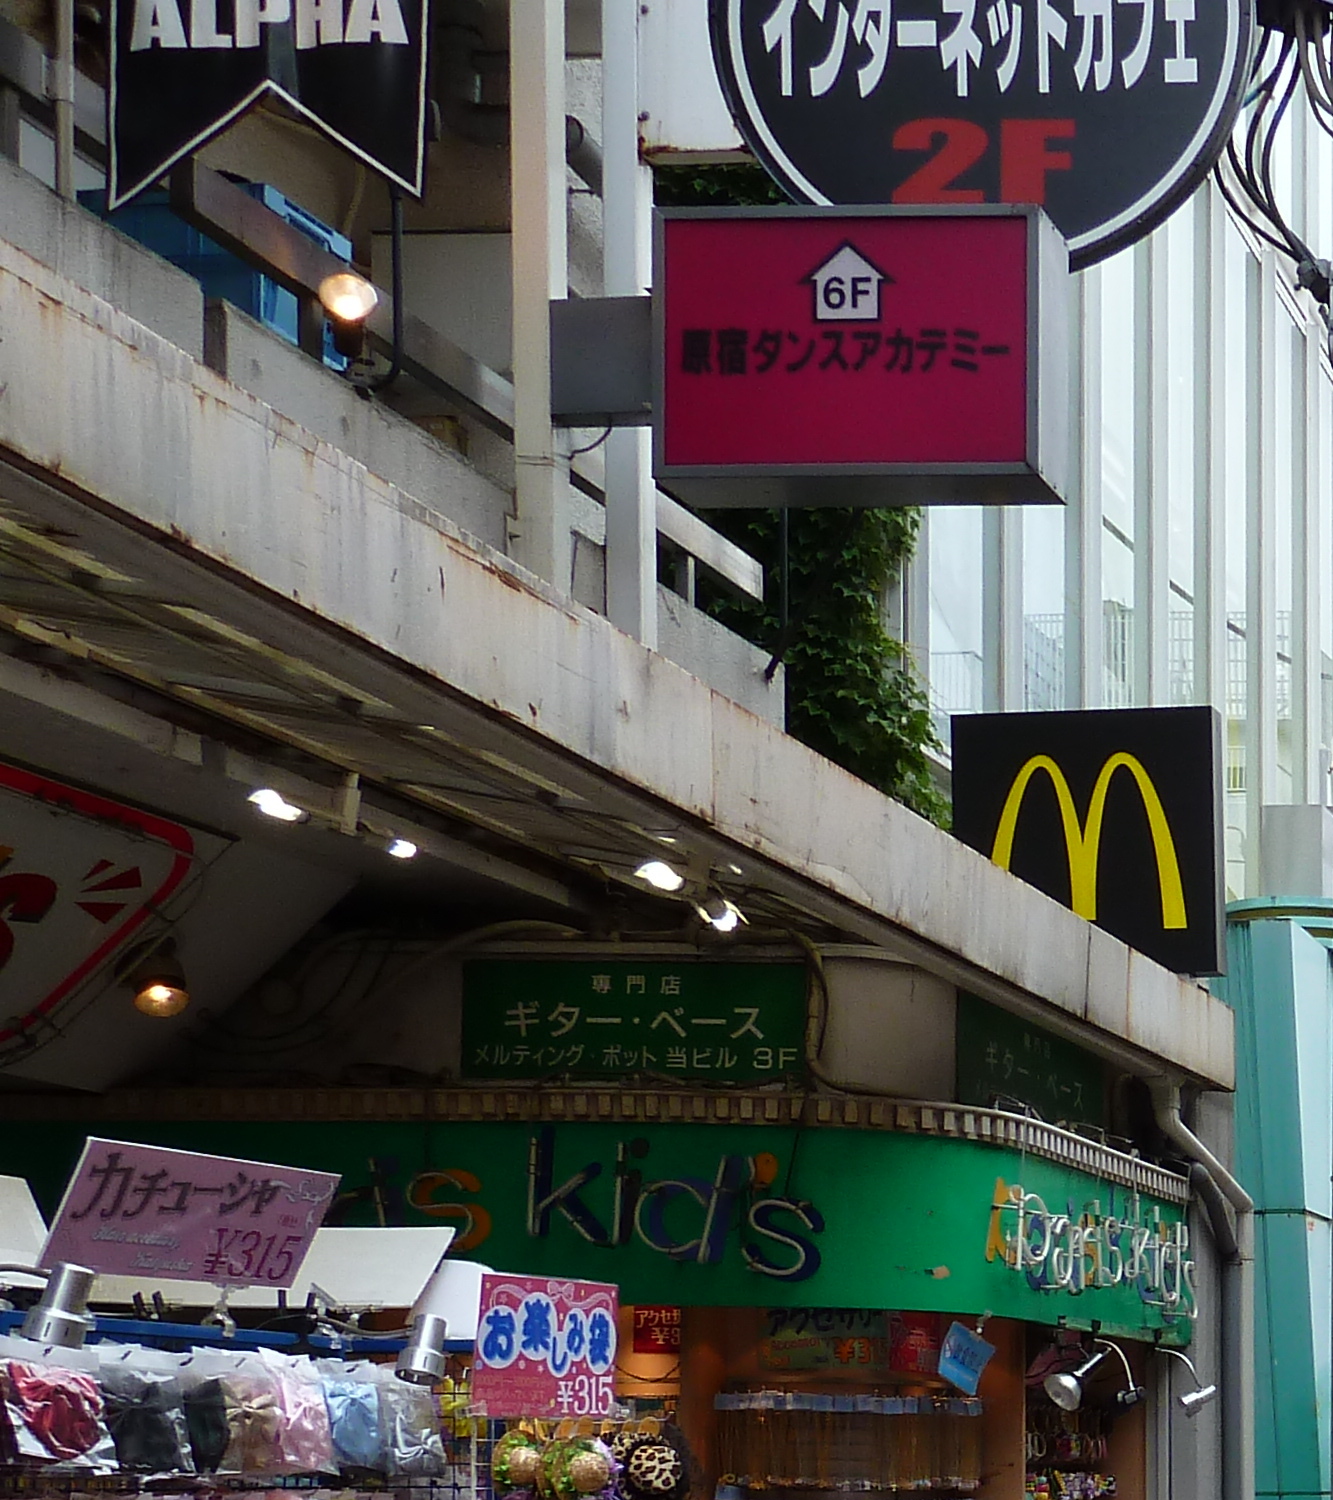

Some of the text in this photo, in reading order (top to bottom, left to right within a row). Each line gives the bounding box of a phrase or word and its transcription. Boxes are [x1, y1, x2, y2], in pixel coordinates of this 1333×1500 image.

[762, 0, 1199, 97] インターネットカフェ
[891, 118, 1076, 204] 2F
[822, 276, 872, 310] 6F
[681, 328, 1010, 376] 原宿ダンスアカデミー
[504, 1001, 765, 1040] ギター・ベース
[203, 1227, 304, 1282] ¥315
[482, 1298, 611, 1373] お楽しみ袋
[557, 1374, 615, 1415] ¥315
